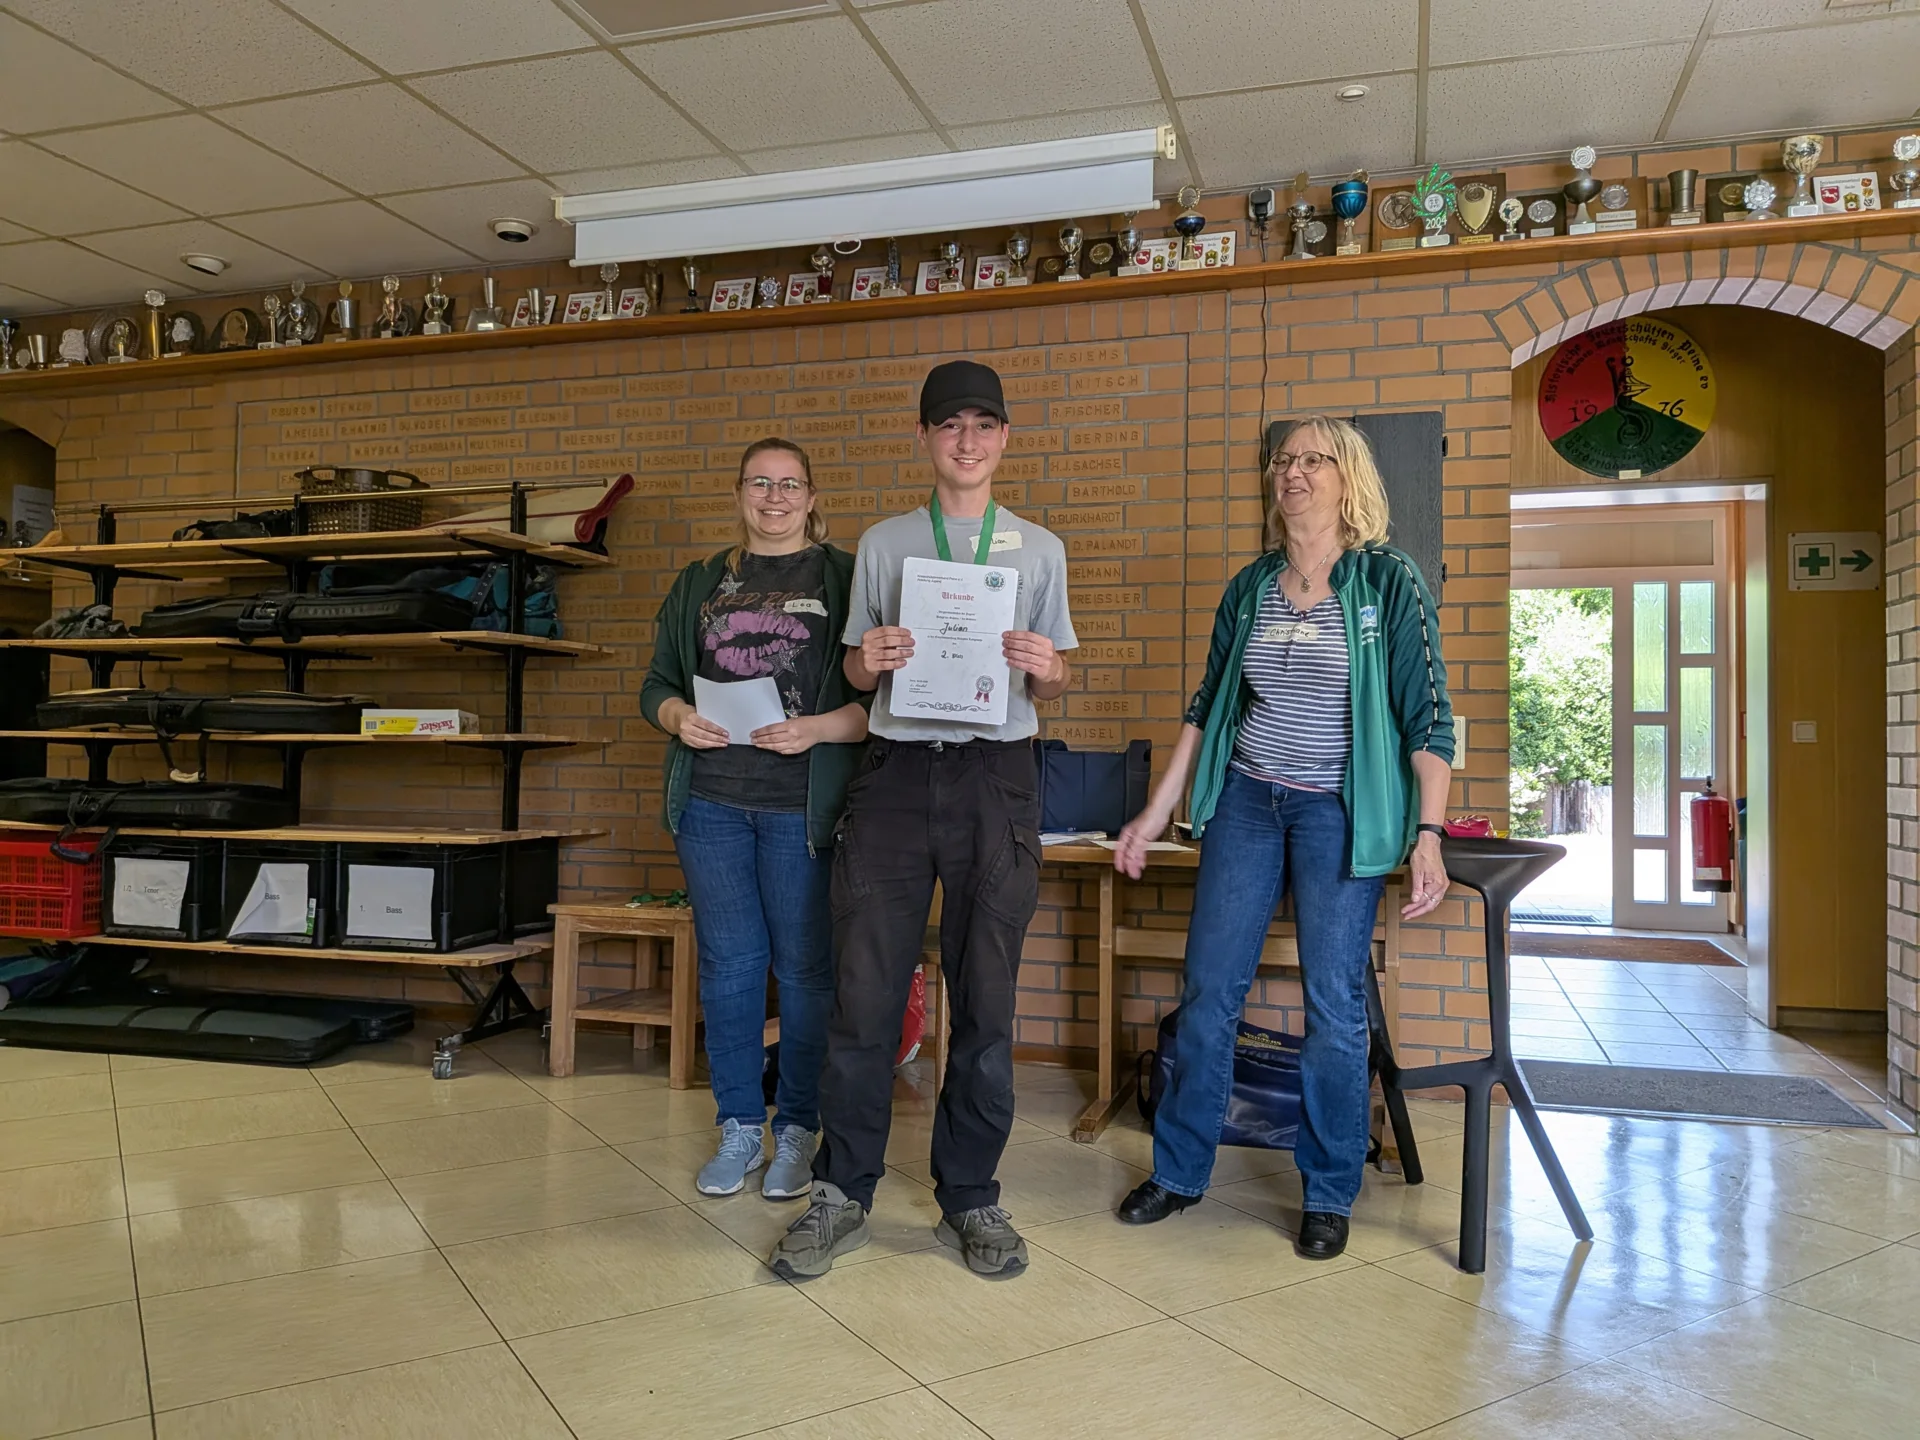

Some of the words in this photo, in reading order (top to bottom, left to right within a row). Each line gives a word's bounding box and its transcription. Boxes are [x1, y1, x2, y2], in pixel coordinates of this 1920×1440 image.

[1056, 350, 1119, 363] F.SIEMS
[1677, 340, 1704, 372] Peine
[799, 370, 855, 382] H.SIEMS
[1075, 374, 1138, 389] NITSCH
[796, 397, 818, 408] UND
[850, 391, 908, 404] EBERMANN
[1052, 403, 1120, 418] R.FISCHER
[626, 429, 684, 442] K.SIEBERT
[1074, 431, 1139, 445] GERBING
[848, 443, 912, 457] SCHIFFNER
[643, 452, 700, 466] H.SCHÜTTE
[814, 472, 853, 484] ETERS
[635, 479, 682, 491] OFFMANN
[1073, 484, 1136, 498] BARTHOLD
[942, 591, 975, 601] Urkunde
[939, 622, 968, 635] Julian
[1269, 624, 1310, 638] Christiane
[143, 886, 160, 895] Tenor
[264, 892, 281, 901] Bass
[386, 906, 403, 915] Bass
